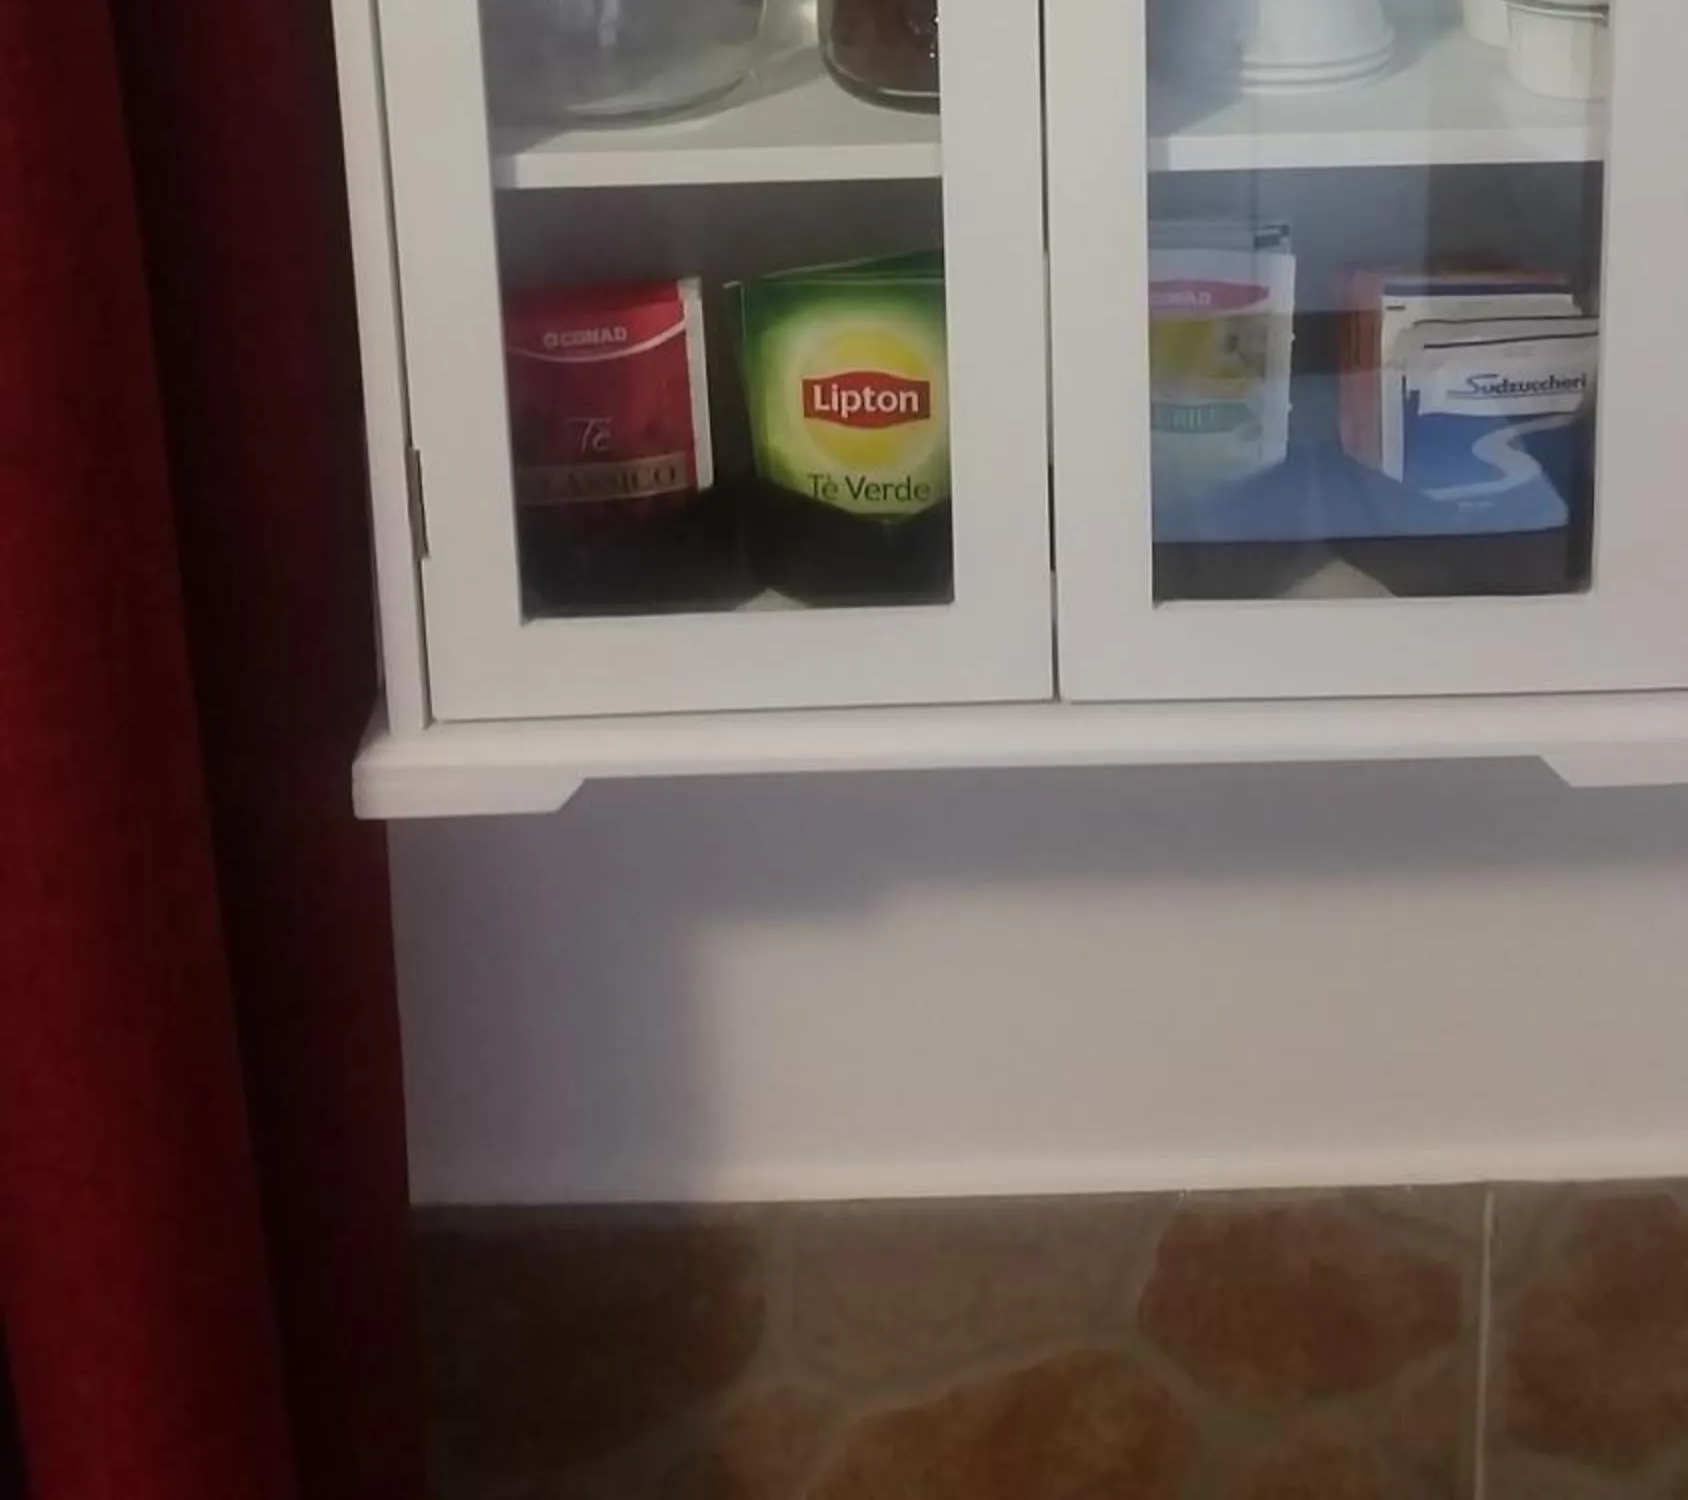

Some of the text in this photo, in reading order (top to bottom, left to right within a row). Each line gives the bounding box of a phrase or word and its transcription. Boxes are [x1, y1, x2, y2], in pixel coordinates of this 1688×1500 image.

[812, 383, 919, 419] Lipton
[807, 472, 930, 501] Tè Verde
